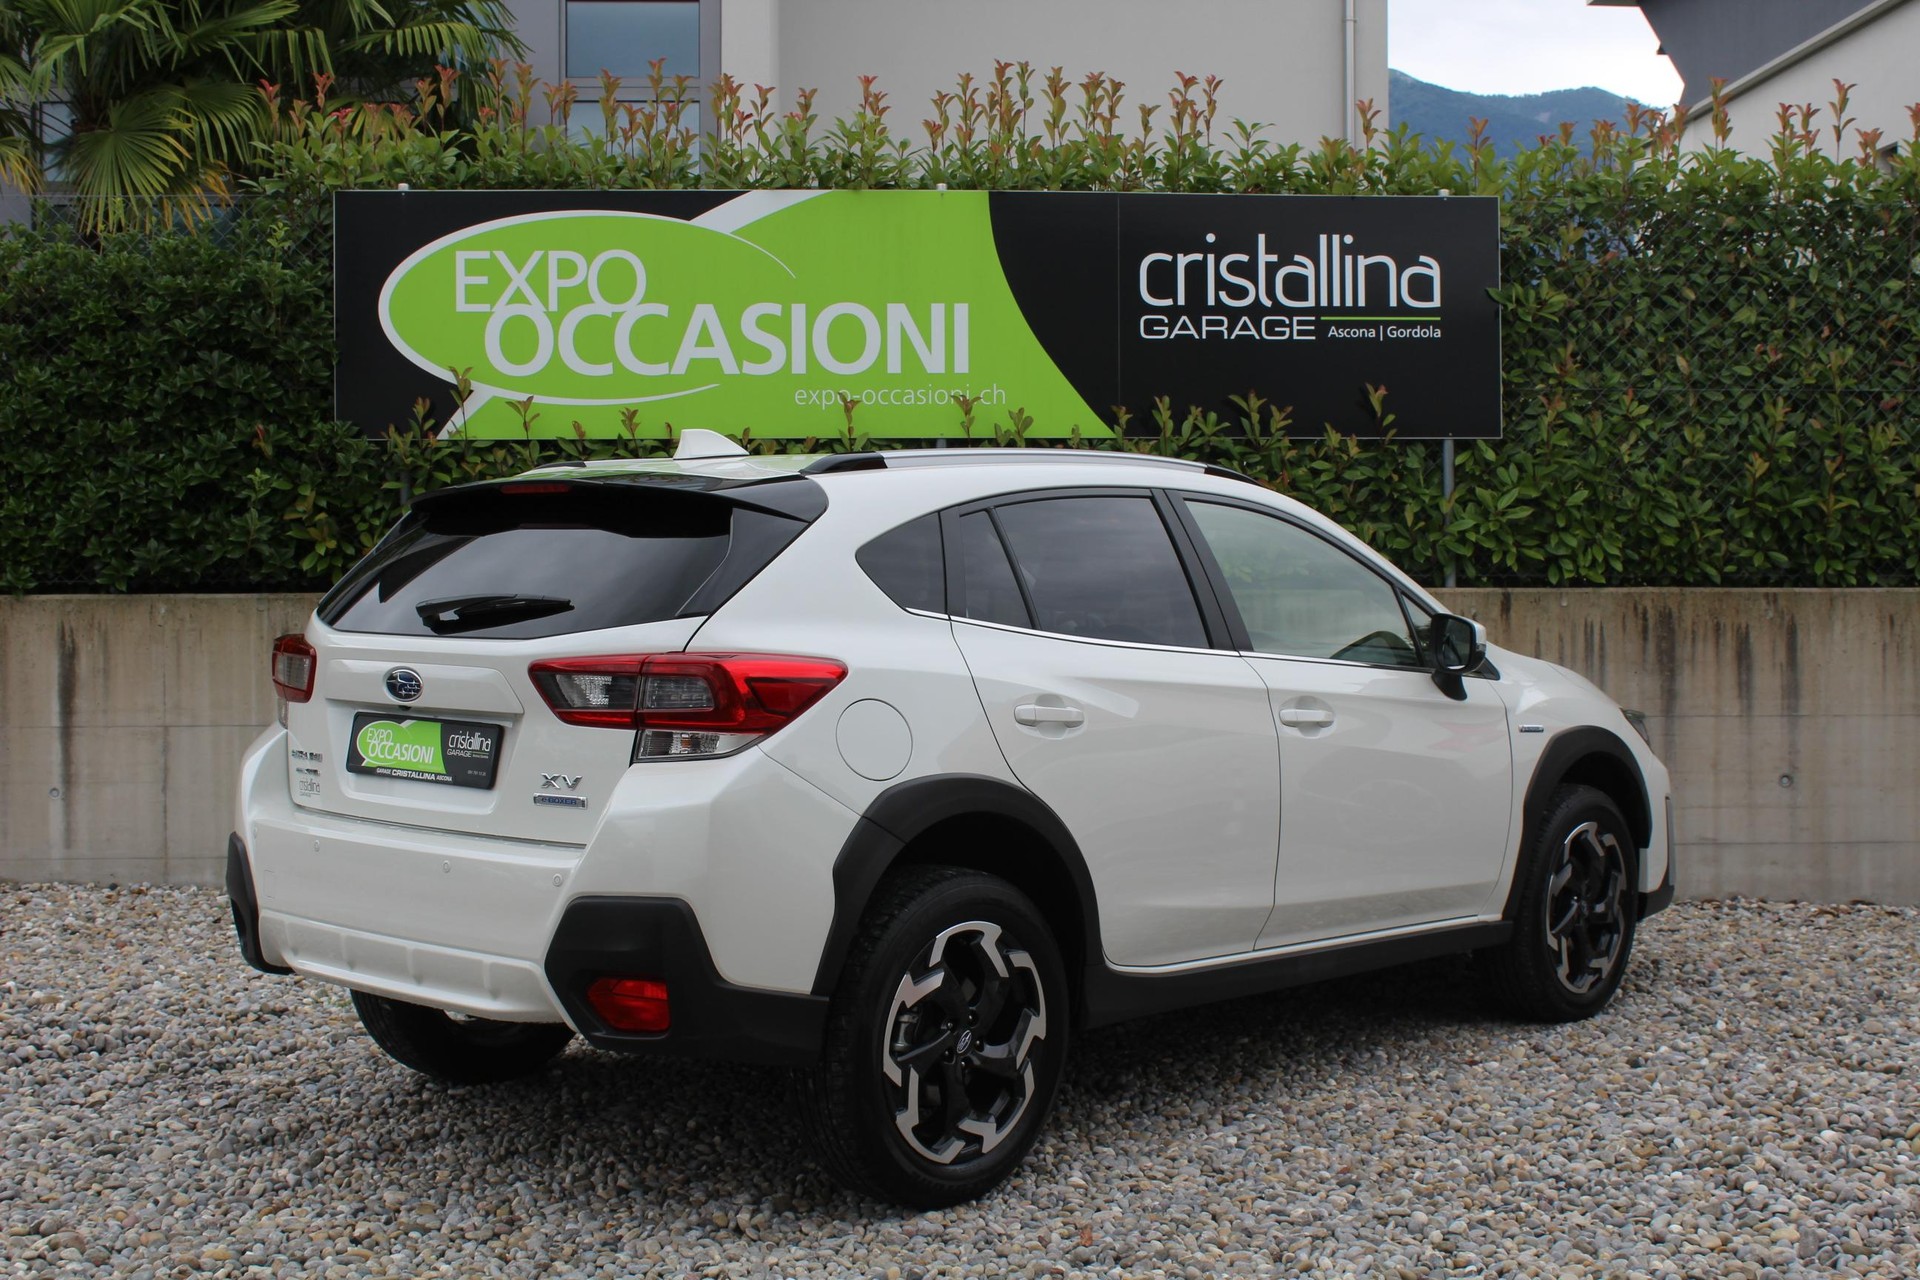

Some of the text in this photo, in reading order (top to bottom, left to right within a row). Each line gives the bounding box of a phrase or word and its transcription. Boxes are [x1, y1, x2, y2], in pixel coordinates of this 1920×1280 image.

[455, 249, 647, 313] EXPO
[1139, 233, 1441, 308] cristallina
[1139, 315, 1316, 340] GARAGE
[1327, 325, 1376, 338] Ascona
[1386, 325, 1442, 338] Gordola
[484, 302, 969, 377] OCCASIONI
[366, 728, 393, 745] EXPO
[448, 730, 492, 752] cristallina
[368, 740, 435, 764] OCCASIONI
[446, 748, 472, 758] GARAGE
[391, 769, 436, 781] CRISTALLINA
[540, 772, 583, 791] XV
